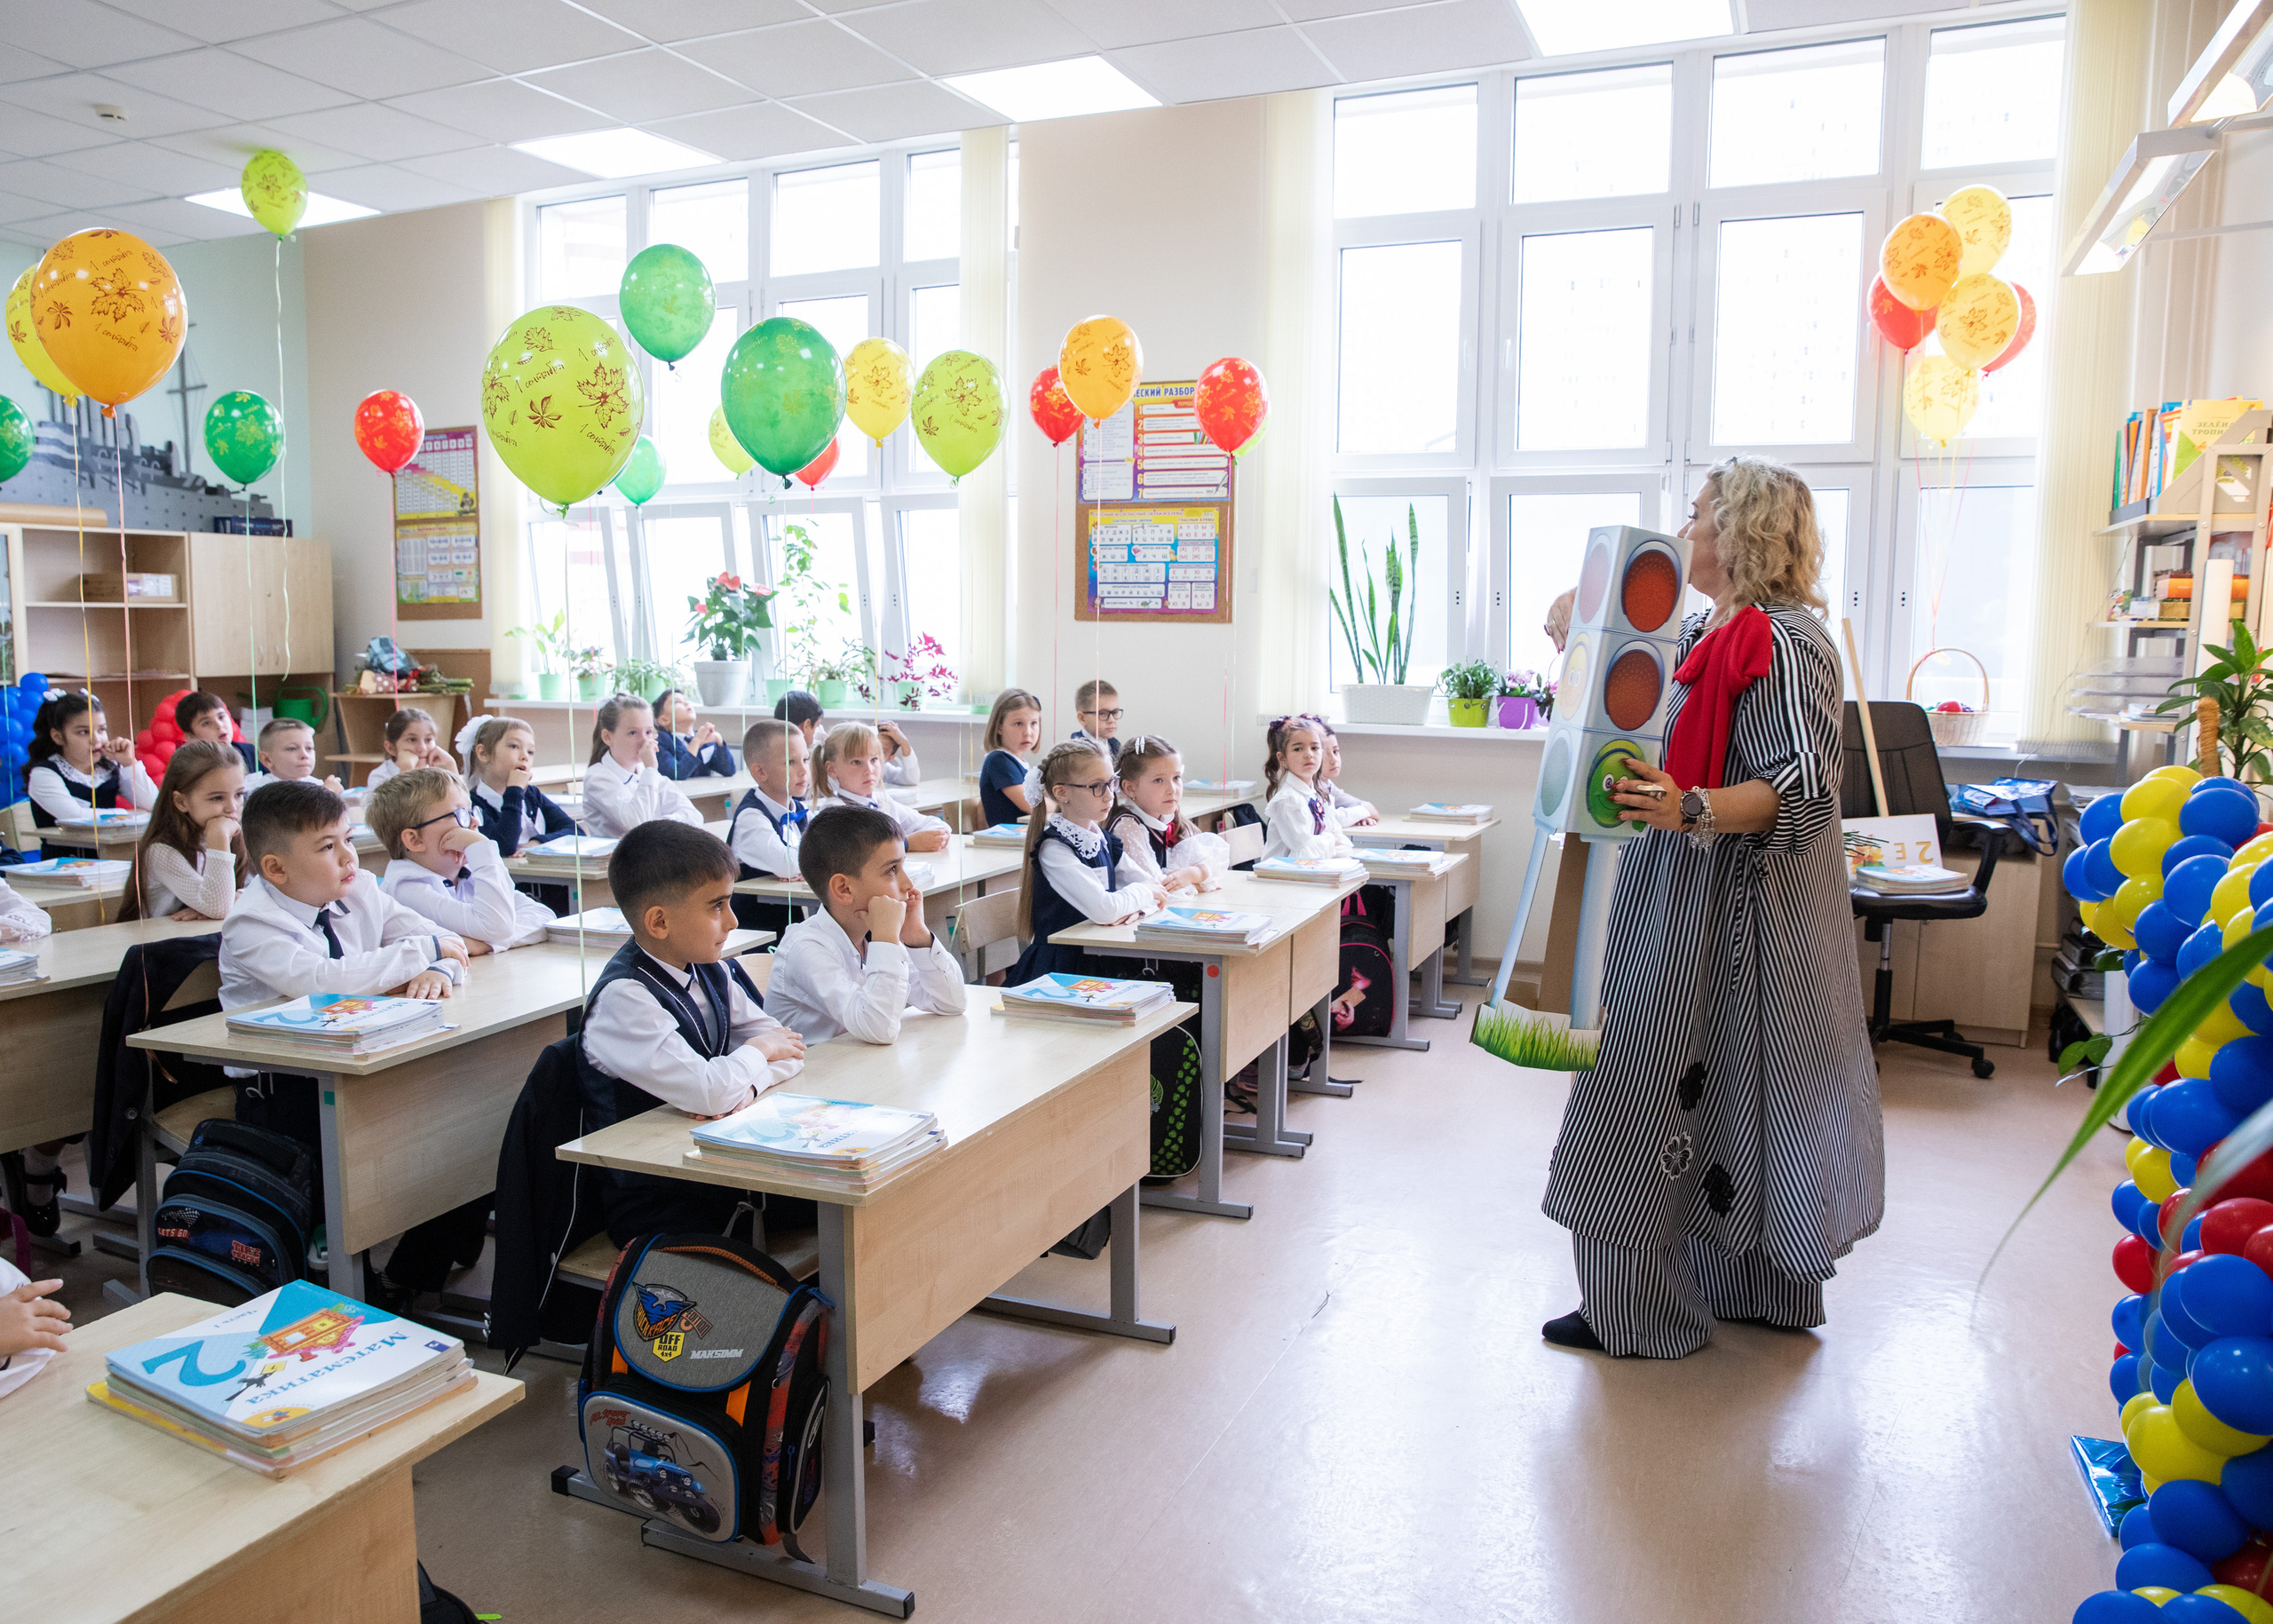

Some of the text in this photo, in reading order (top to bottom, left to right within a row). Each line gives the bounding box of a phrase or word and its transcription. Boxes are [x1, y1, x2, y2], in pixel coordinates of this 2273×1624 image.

[1134, 387, 1195, 398] ЕСКИЙ РАЗБОР
[252, 1012, 319, 1025] 2
[659, 1334, 681, 1345] OFF
[142, 1339, 246, 1387] 2
[245, 1331, 412, 1405] Математика
